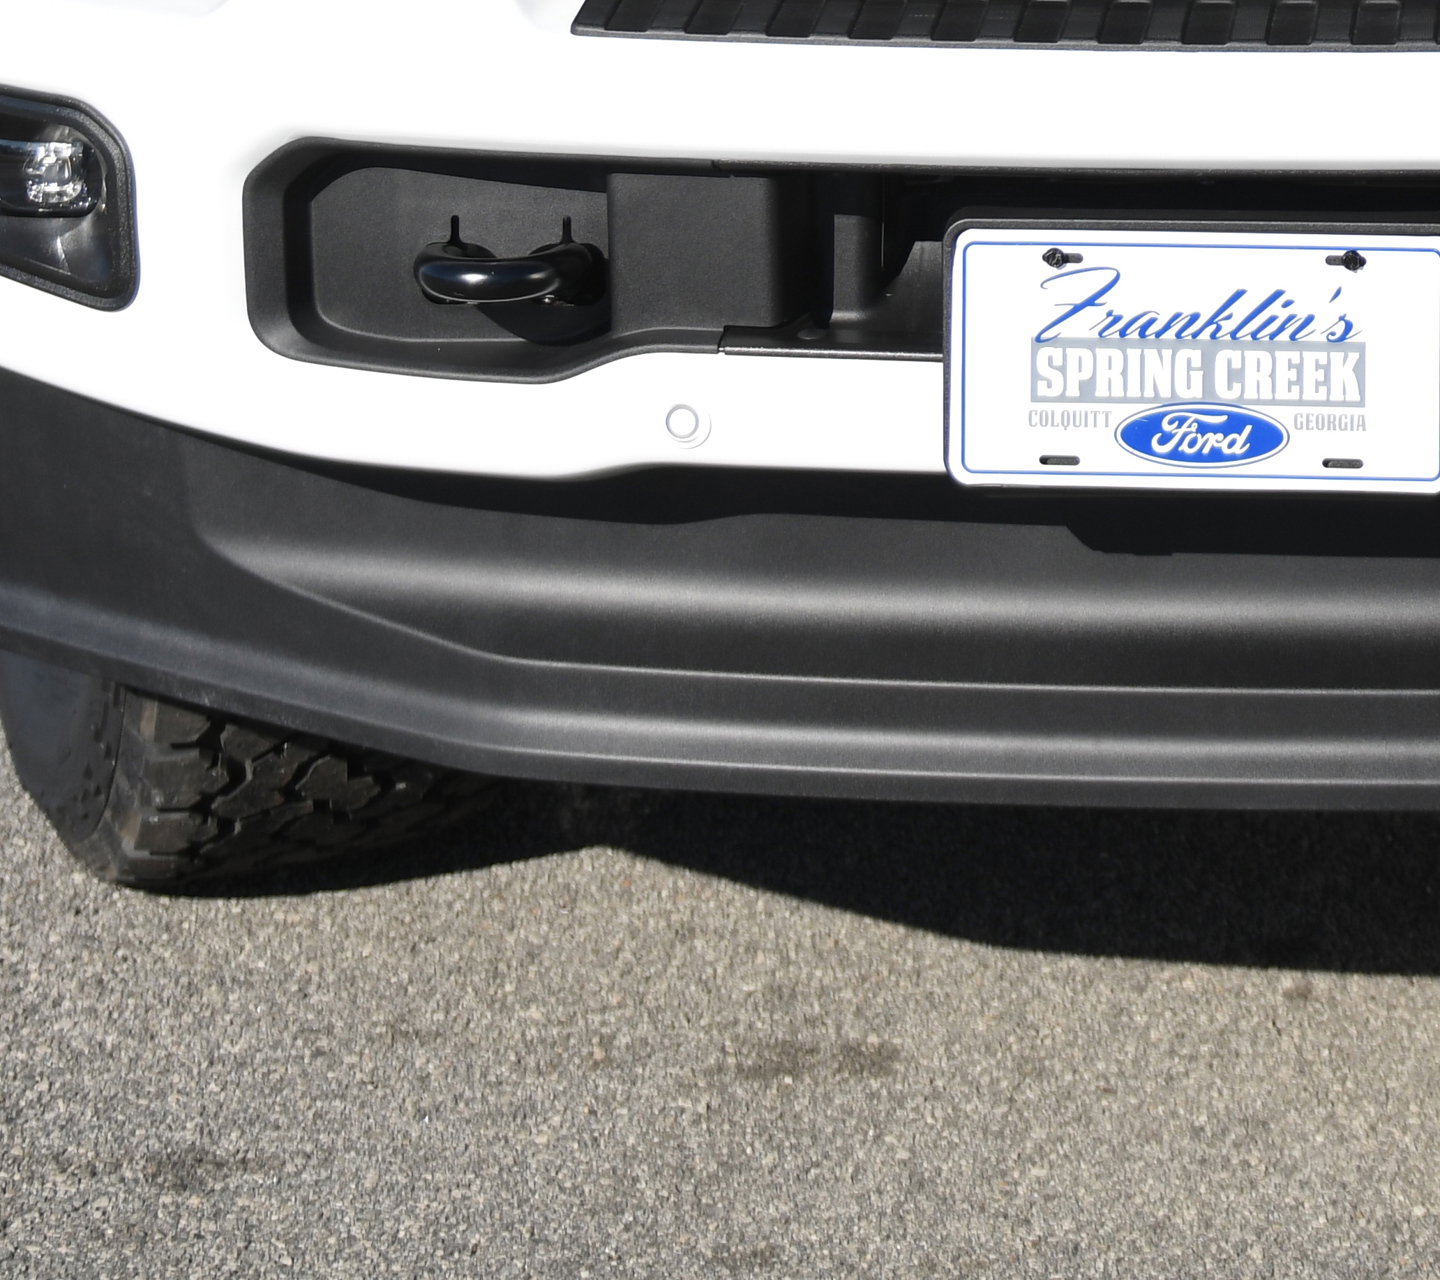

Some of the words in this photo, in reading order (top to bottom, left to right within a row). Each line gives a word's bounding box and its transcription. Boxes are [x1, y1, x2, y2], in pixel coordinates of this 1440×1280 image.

[1034, 266, 1363, 343] Franklin's
[1036, 345, 1205, 399] SPRING
[1215, 348, 1362, 402] CREEK
[1027, 409, 1114, 432] COLQUITT
[1151, 412, 1252, 456] Ford
[1293, 412, 1368, 433] GEORGIA
